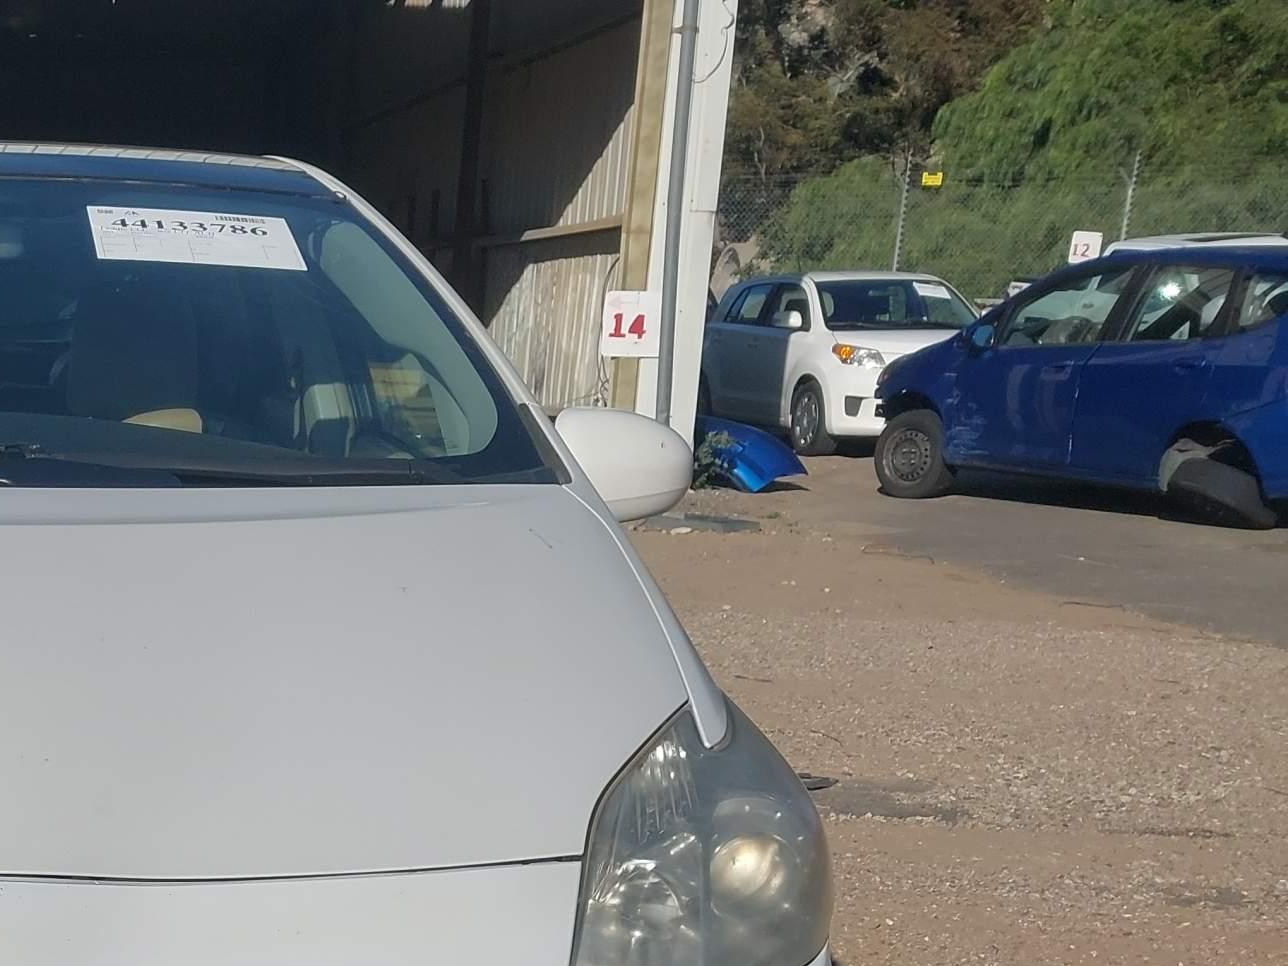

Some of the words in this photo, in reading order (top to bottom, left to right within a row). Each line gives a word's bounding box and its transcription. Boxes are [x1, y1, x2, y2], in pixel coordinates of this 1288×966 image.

[111, 218, 268, 237] 44133786
[1072, 243, 1090, 258] 12
[608, 312, 647, 340] 14
